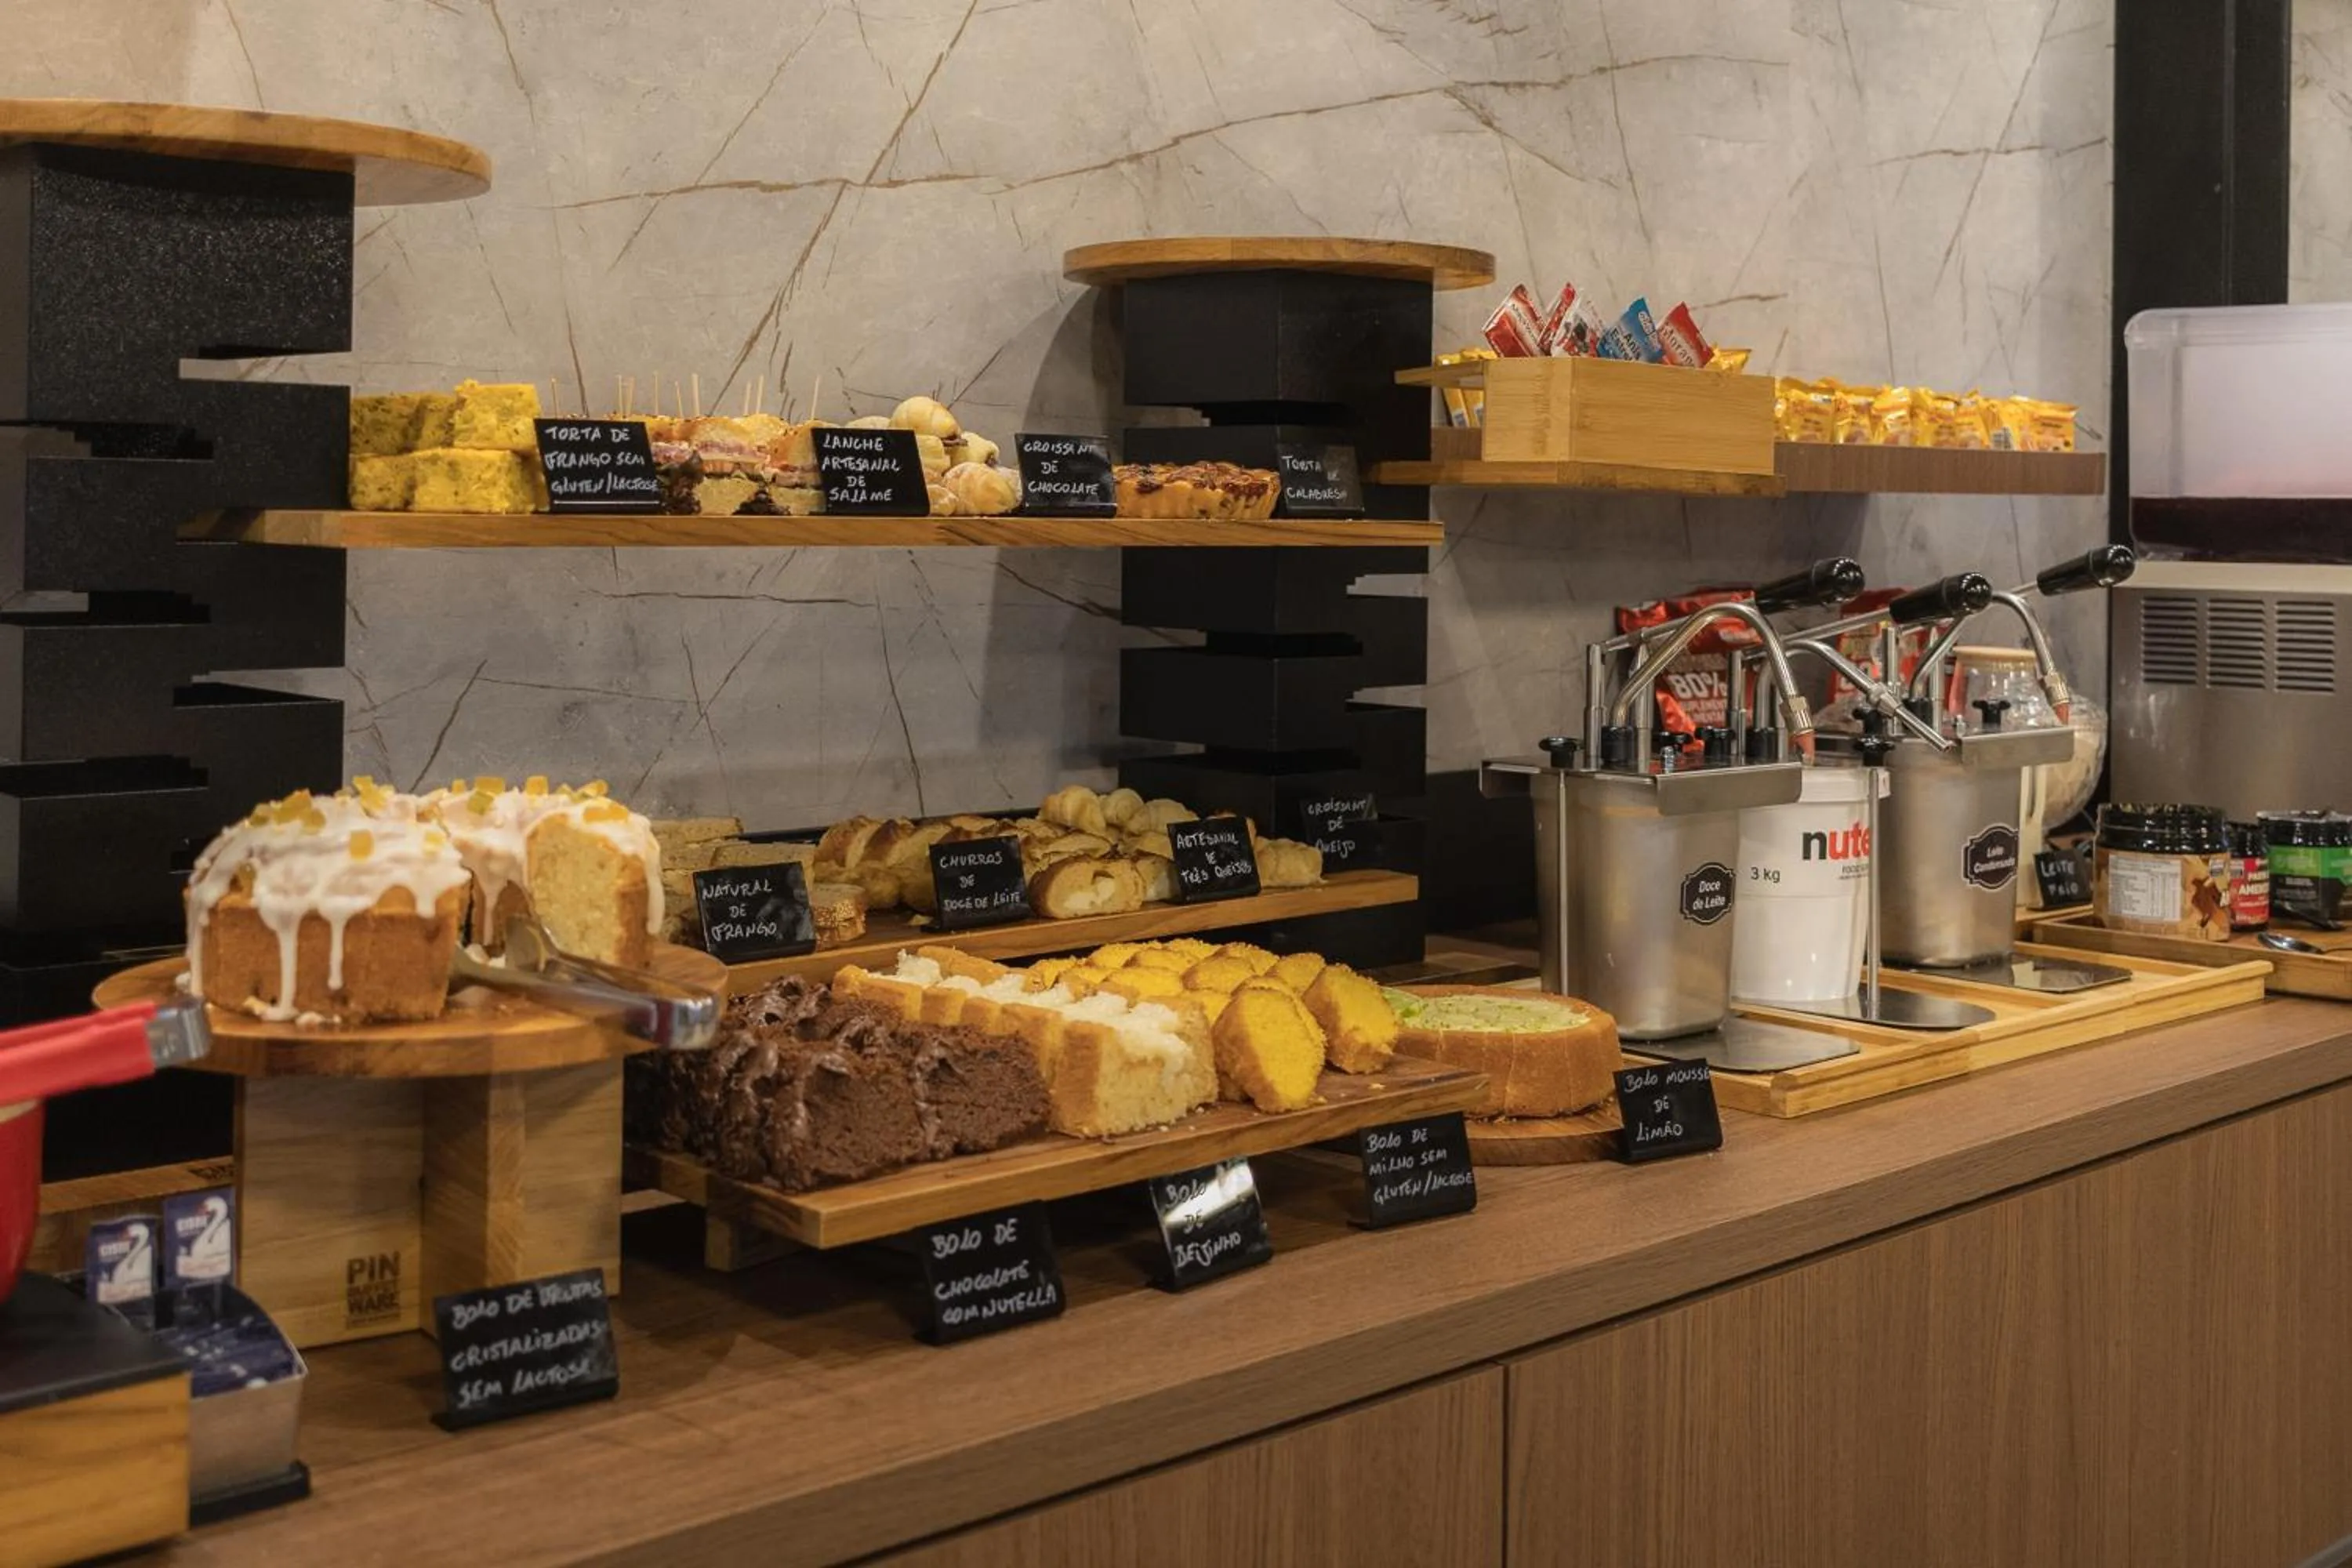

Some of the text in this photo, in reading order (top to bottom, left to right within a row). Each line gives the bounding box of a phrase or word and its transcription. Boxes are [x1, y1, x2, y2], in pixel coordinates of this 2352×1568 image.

[546, 426, 630, 443] TORTA DE
[823, 433, 884, 451] LANCHE
[544, 451, 645, 470] FRANGO SEM
[822, 456, 901, 471] ARTESANAL
[1041, 460, 1058, 474] DE
[847, 476, 866, 487] DE
[1027, 481, 1099, 495] CHOCOLATE
[829, 487, 892, 502] SALAME
[940, 851, 1003, 868] CHURROS
[959, 874, 975, 888] DE
[1751, 867, 1780, 883] 3 kg
[702, 878, 771, 900] NATURAL
[1698, 880, 1721, 894] Doce
[728, 903, 746, 918] DE
[944, 897, 972, 910] DOCE
[975, 897, 989, 908] DE
[711, 922, 777, 942] FRANGO
[1624, 1067, 1711, 1092] BOLO MOUSSE
[1653, 1096, 1669, 1112] DE
[1367, 1128, 1428, 1153] BOLO DE
[1421, 1149, 1447, 1165] SEM
[1165, 1178, 1207, 1208] BOLO
[931, 1218, 1018, 1259] BOLO DE
[347, 1250, 401, 1285] PIN
[934, 1259, 1029, 1301] CHOCOLATE
[452, 1298, 499, 1330] BOLO
[506, 1289, 534, 1314] DE
[942, 1283, 1057, 1324] COM NUTELLA
[450, 1319, 602, 1372] CRISTALIZADAS
[457, 1358, 590, 1409] SEM LACTOSE
